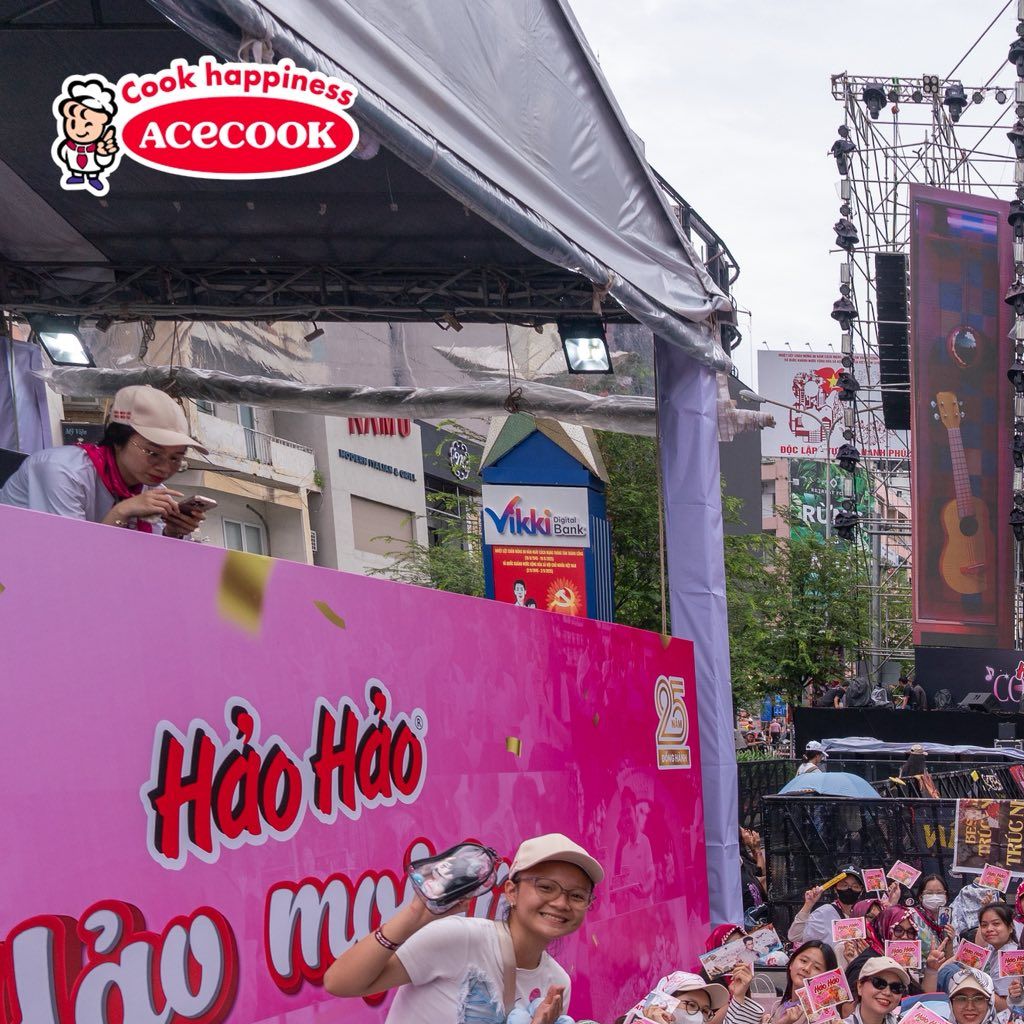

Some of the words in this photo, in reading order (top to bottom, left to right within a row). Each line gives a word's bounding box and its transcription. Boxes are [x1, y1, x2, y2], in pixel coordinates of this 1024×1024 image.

[780, 446, 798, 455] ĐỘC
[801, 446, 818, 455] LẬP
[484, 496, 552, 536] Vikki
[553, 516, 577, 524] Digital
[553, 524, 585, 535] Bank
[656, 677, 688, 745] 25
[148, 704, 301, 860] Hảo
[309, 685, 424, 815] Hảo
